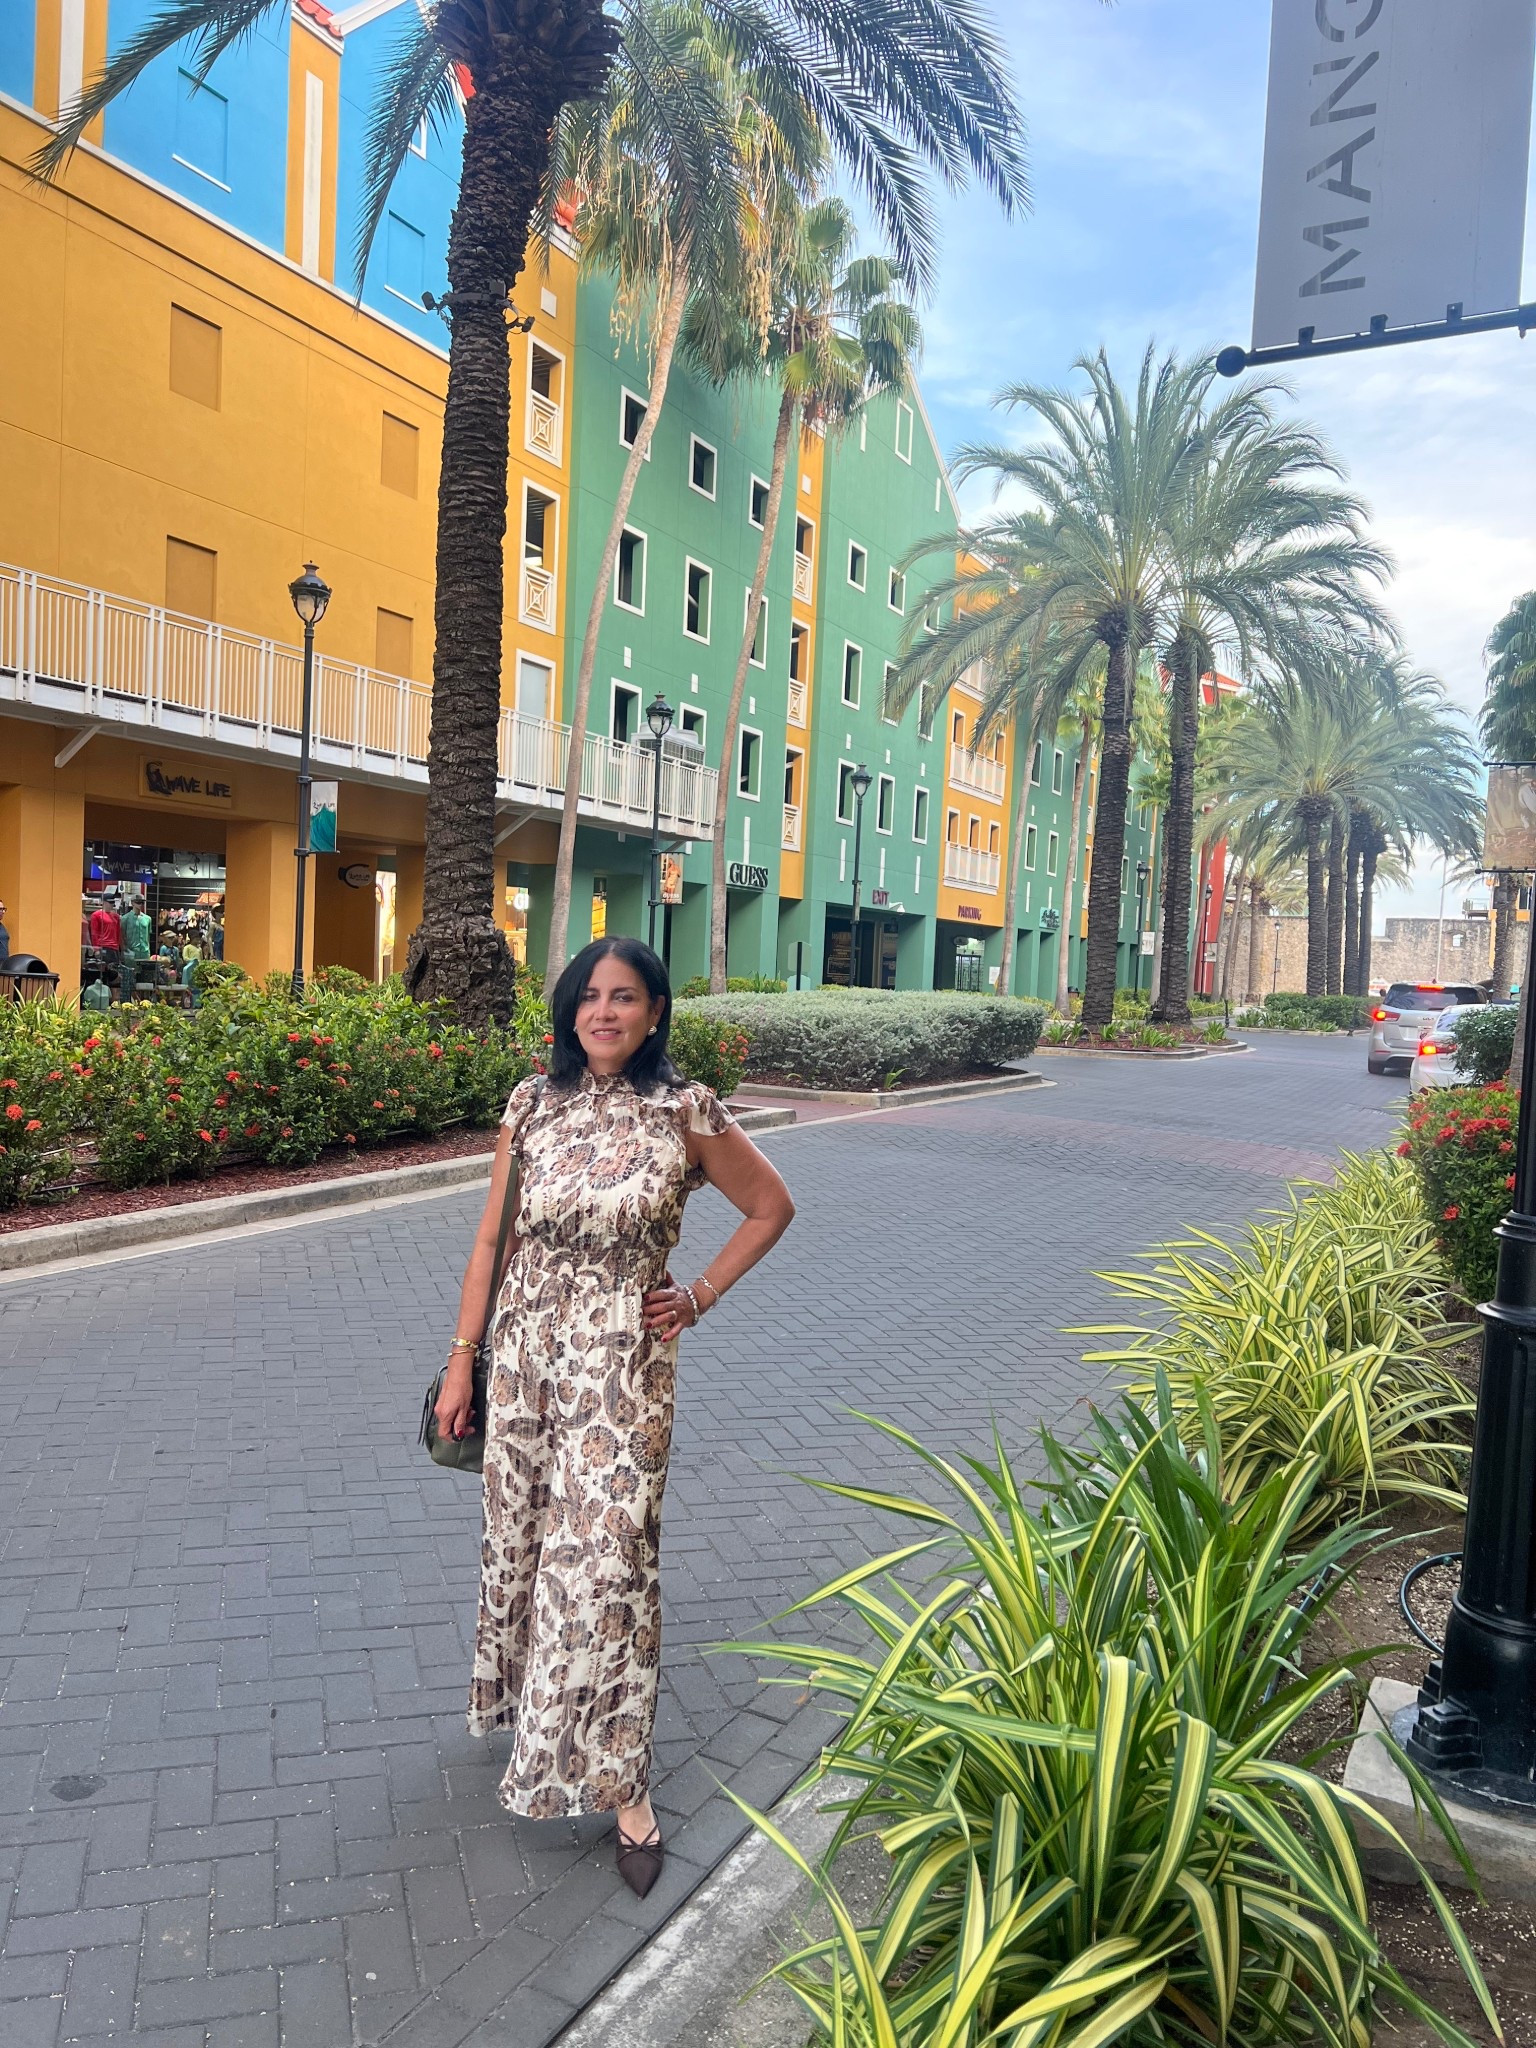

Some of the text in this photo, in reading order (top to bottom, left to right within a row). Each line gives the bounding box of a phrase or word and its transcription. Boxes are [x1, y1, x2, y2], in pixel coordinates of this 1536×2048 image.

[1299, 0, 1384, 298] MANG
[166, 775, 232, 797] WAVE LIFE
[107, 861, 152, 874] WAVE LIFE
[729, 862, 769, 888] GUESS
[872, 889, 889, 906] EXIT
[957, 904, 982, 921] PARKING
